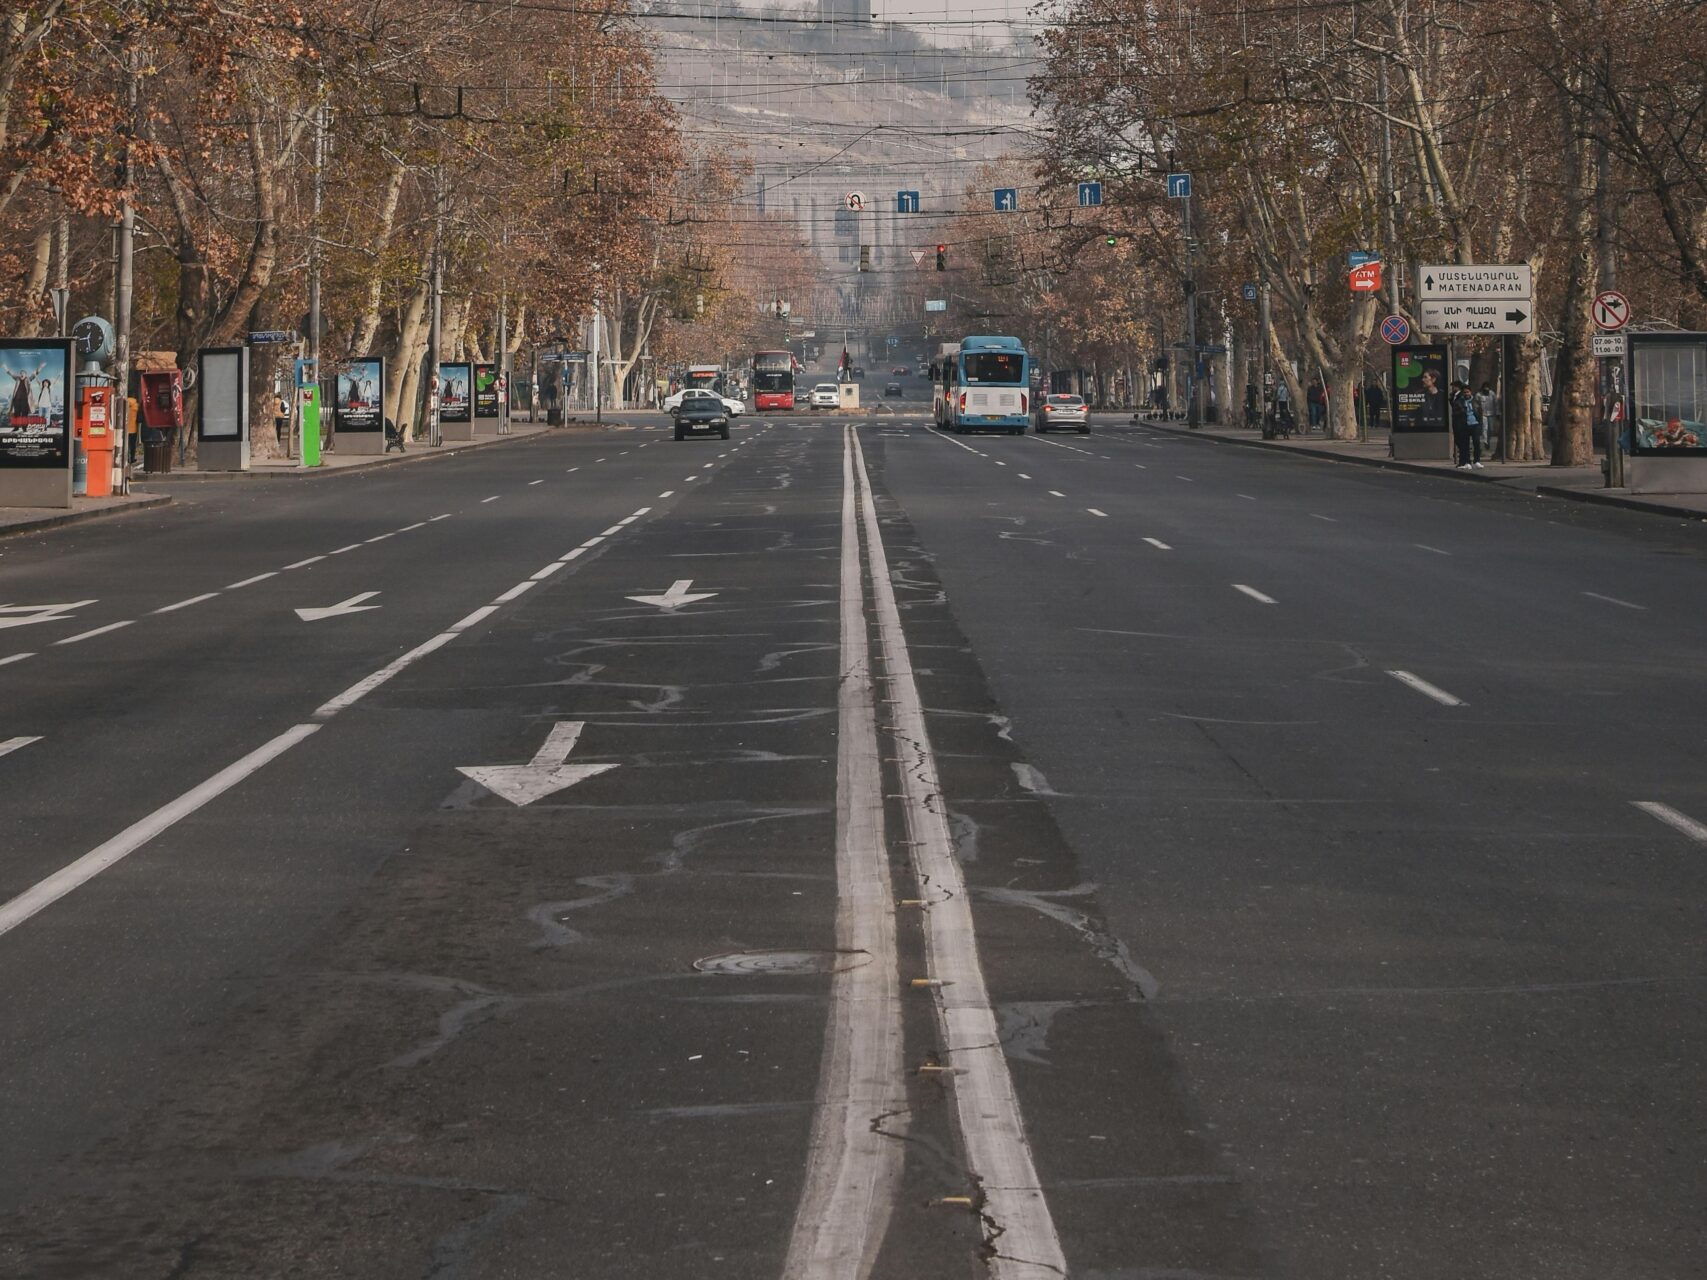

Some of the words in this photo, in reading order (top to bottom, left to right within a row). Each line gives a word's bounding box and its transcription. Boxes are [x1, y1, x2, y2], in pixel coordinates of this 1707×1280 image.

[1355, 270, 1375, 278] ATM
[1438, 272, 1520, 281] ՄԱՏԵՆԱԴԱՐԱՆ
[1439, 283, 1522, 292] MATENADARAN
[1443, 306, 1462, 315] ԱՆԻ
[1465, 306, 1497, 315] ՊԼԱԶԱ
[1444, 321, 1459, 330] ANI
[1466, 321, 1496, 330] PLAZA
